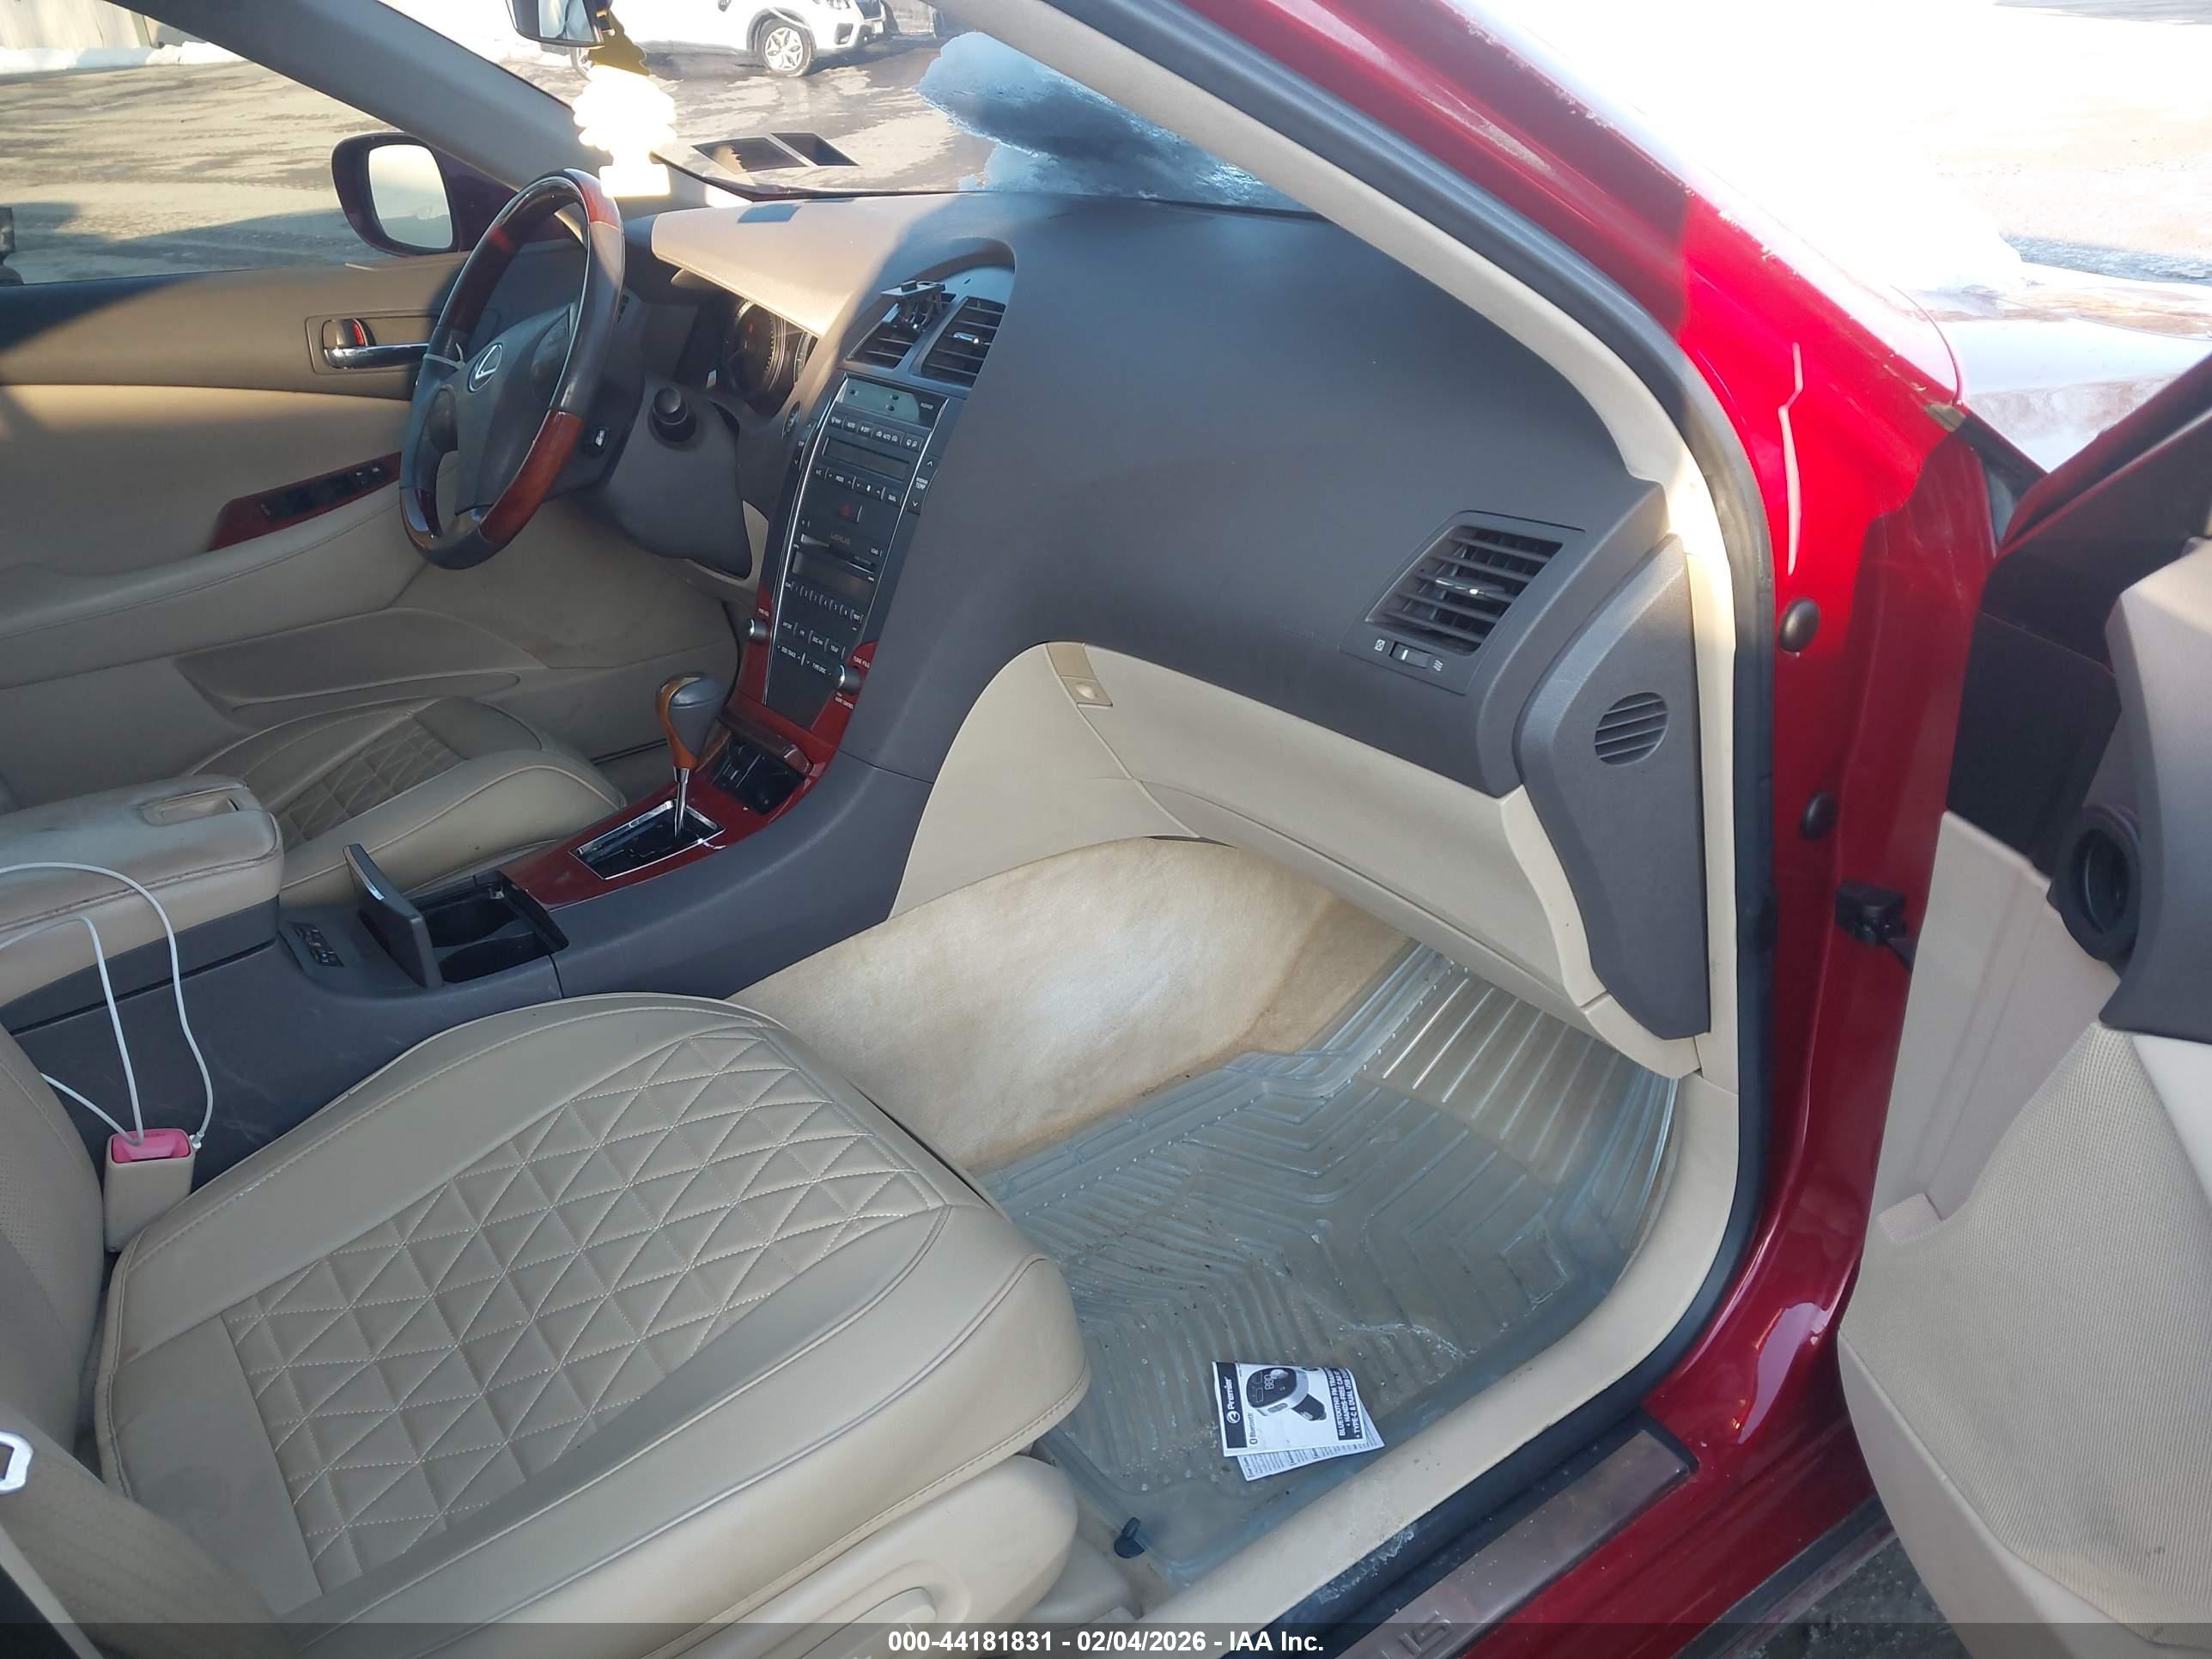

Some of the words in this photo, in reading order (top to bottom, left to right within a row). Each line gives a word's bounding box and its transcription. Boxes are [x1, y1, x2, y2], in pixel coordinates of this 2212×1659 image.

[1224, 1376, 1236, 1410] Premier
[1339, 1385, 1352, 1423] HANDS-FREE
[1346, 1390, 1355, 1407] DUAL
[1248, 1413, 1257, 1438] Bluetooth
[1351, 1412, 1361, 1434] TYPE-C
